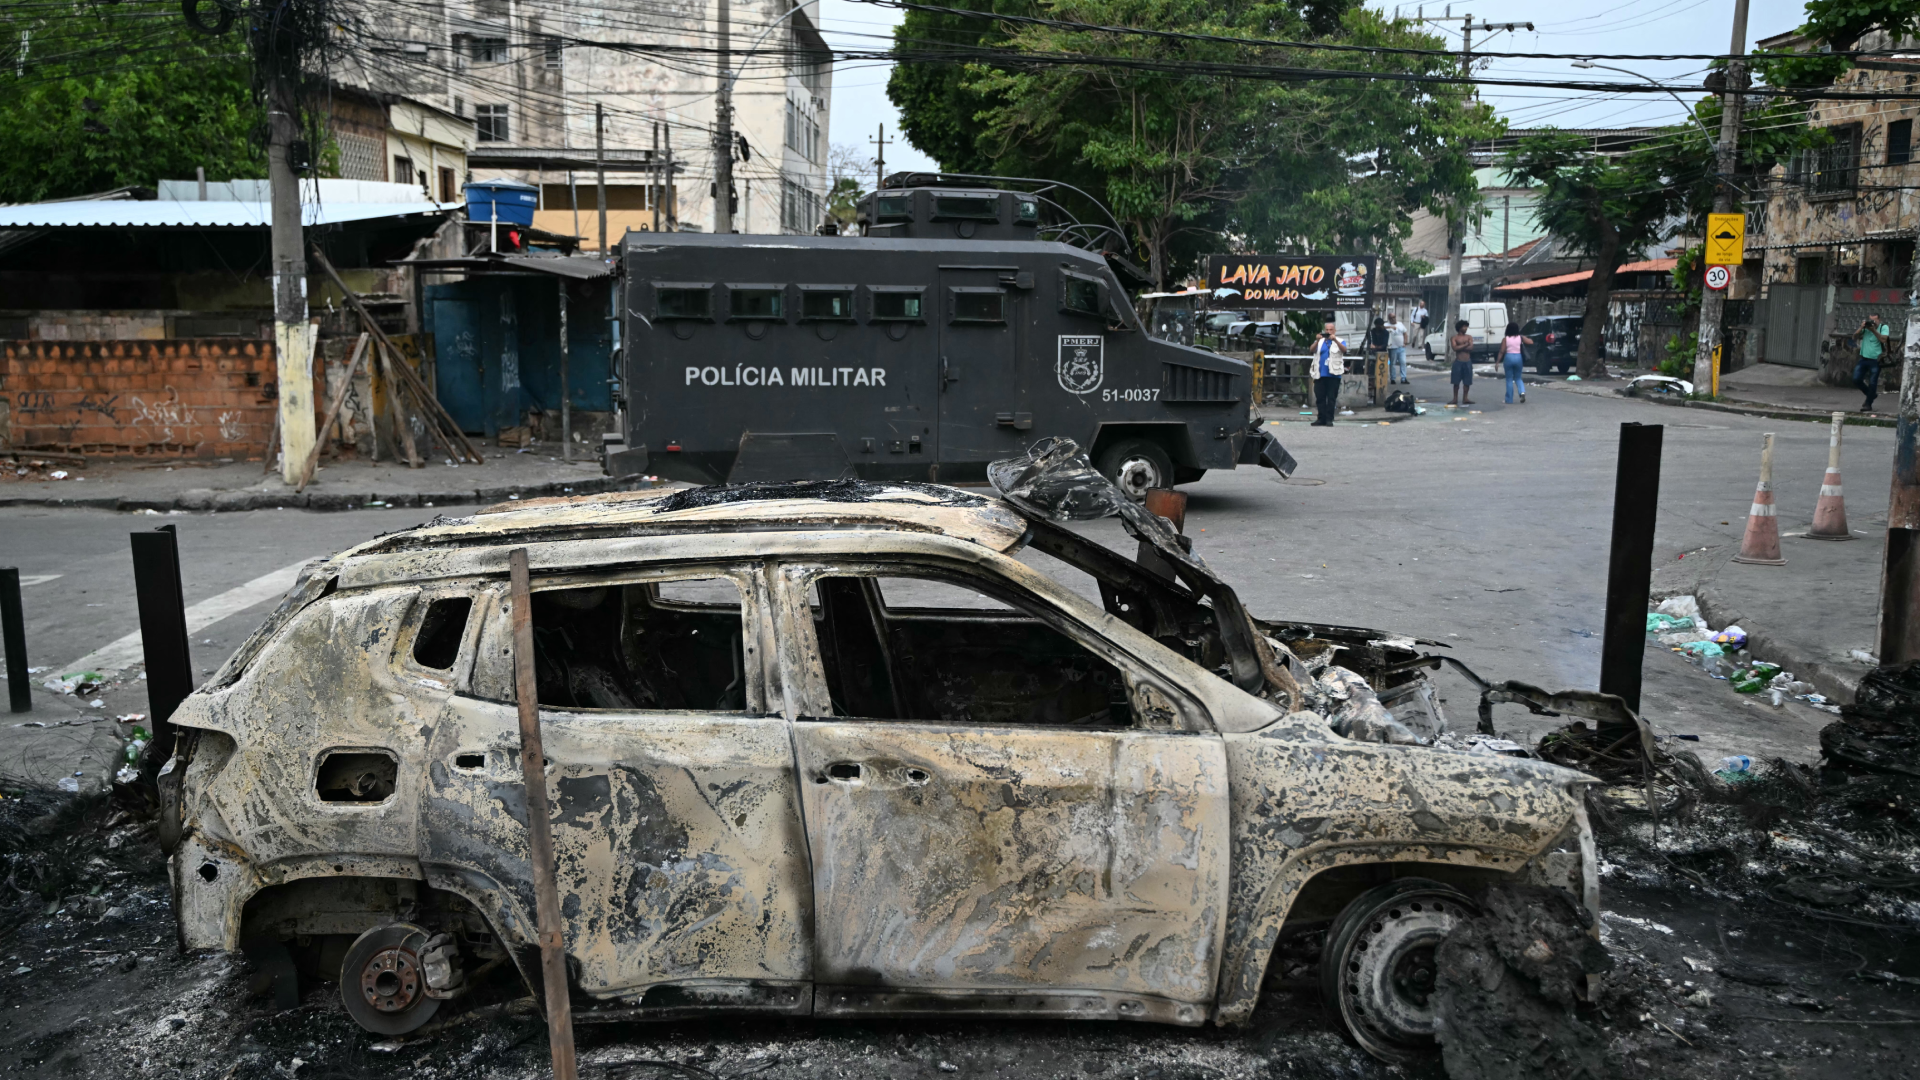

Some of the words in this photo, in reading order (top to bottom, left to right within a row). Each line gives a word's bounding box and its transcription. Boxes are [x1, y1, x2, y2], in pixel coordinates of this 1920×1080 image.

[1220, 264, 1271, 286] LAVA
[1275, 264, 1325, 286] JATO
[1709, 269, 1726, 282] 30
[1244, 289, 1262, 301] DO
[1263, 287, 1299, 301] VALÃO
[685, 362, 784, 386] POLÍCIA
[791, 367, 886, 387] MILITAR
[1102, 389, 1161, 402] 51-0037
